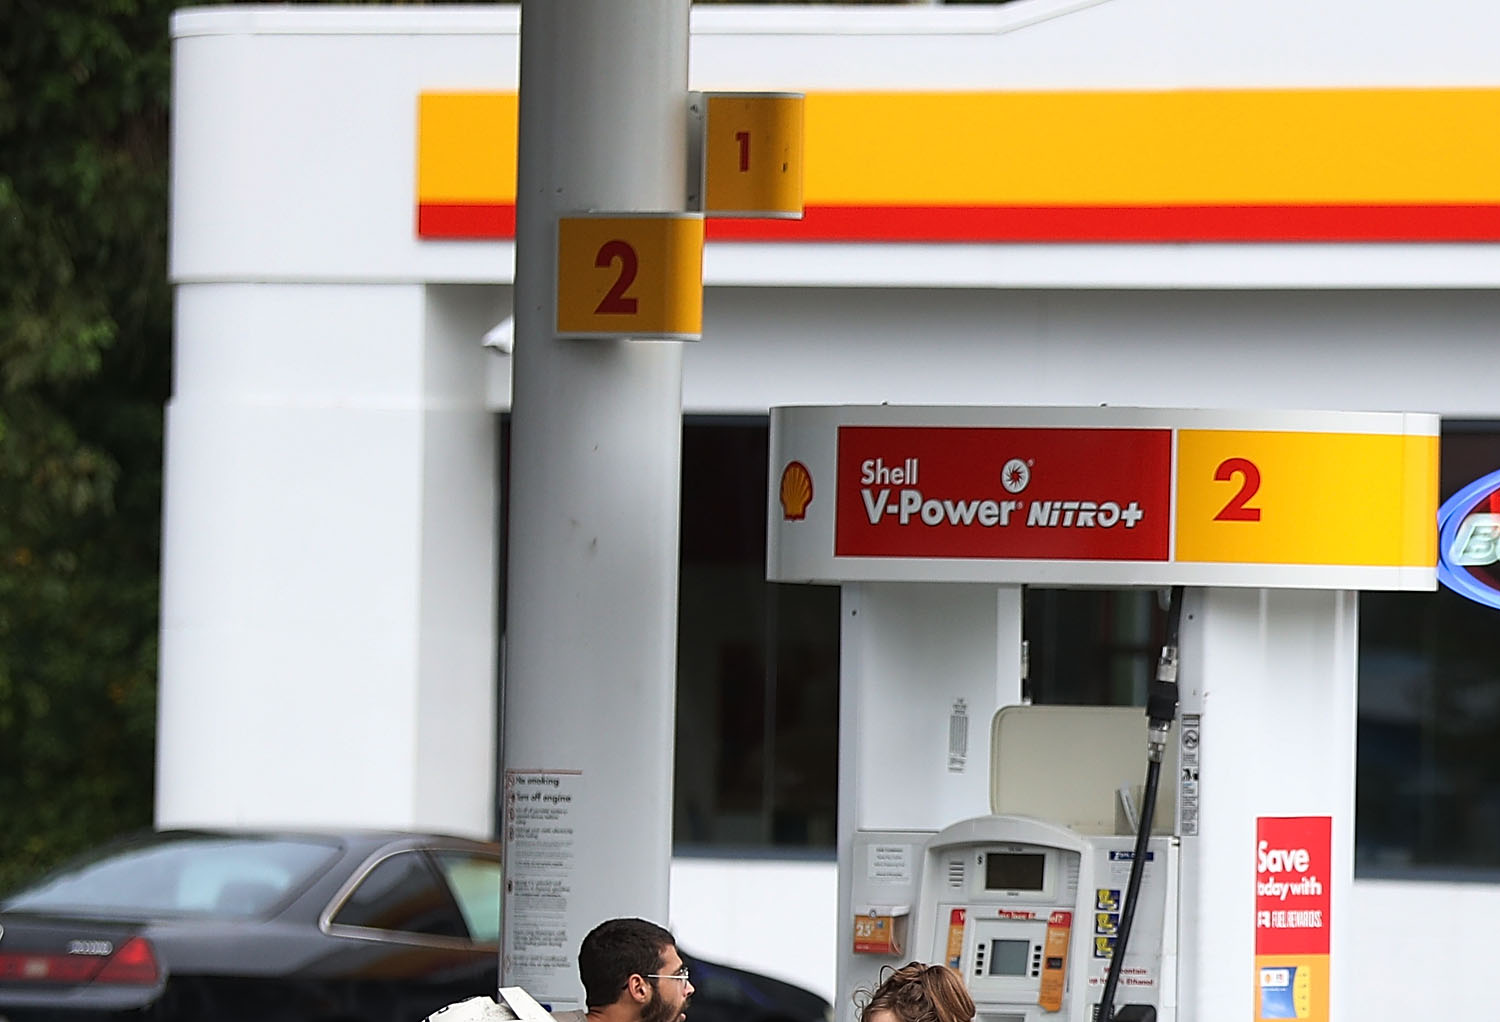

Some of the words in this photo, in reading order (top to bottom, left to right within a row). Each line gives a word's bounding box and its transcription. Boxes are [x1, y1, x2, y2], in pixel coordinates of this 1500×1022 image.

[735, 131, 750, 173] 1
[593, 240, 640, 315] 2
[860, 458, 918, 485] Shell
[860, 489, 1017, 526] V-Power
[1213, 458, 1261, 522] 2
[543, 794, 572, 805] engine
[1257, 839, 1310, 873] Save
[1289, 875, 1323, 896] with
